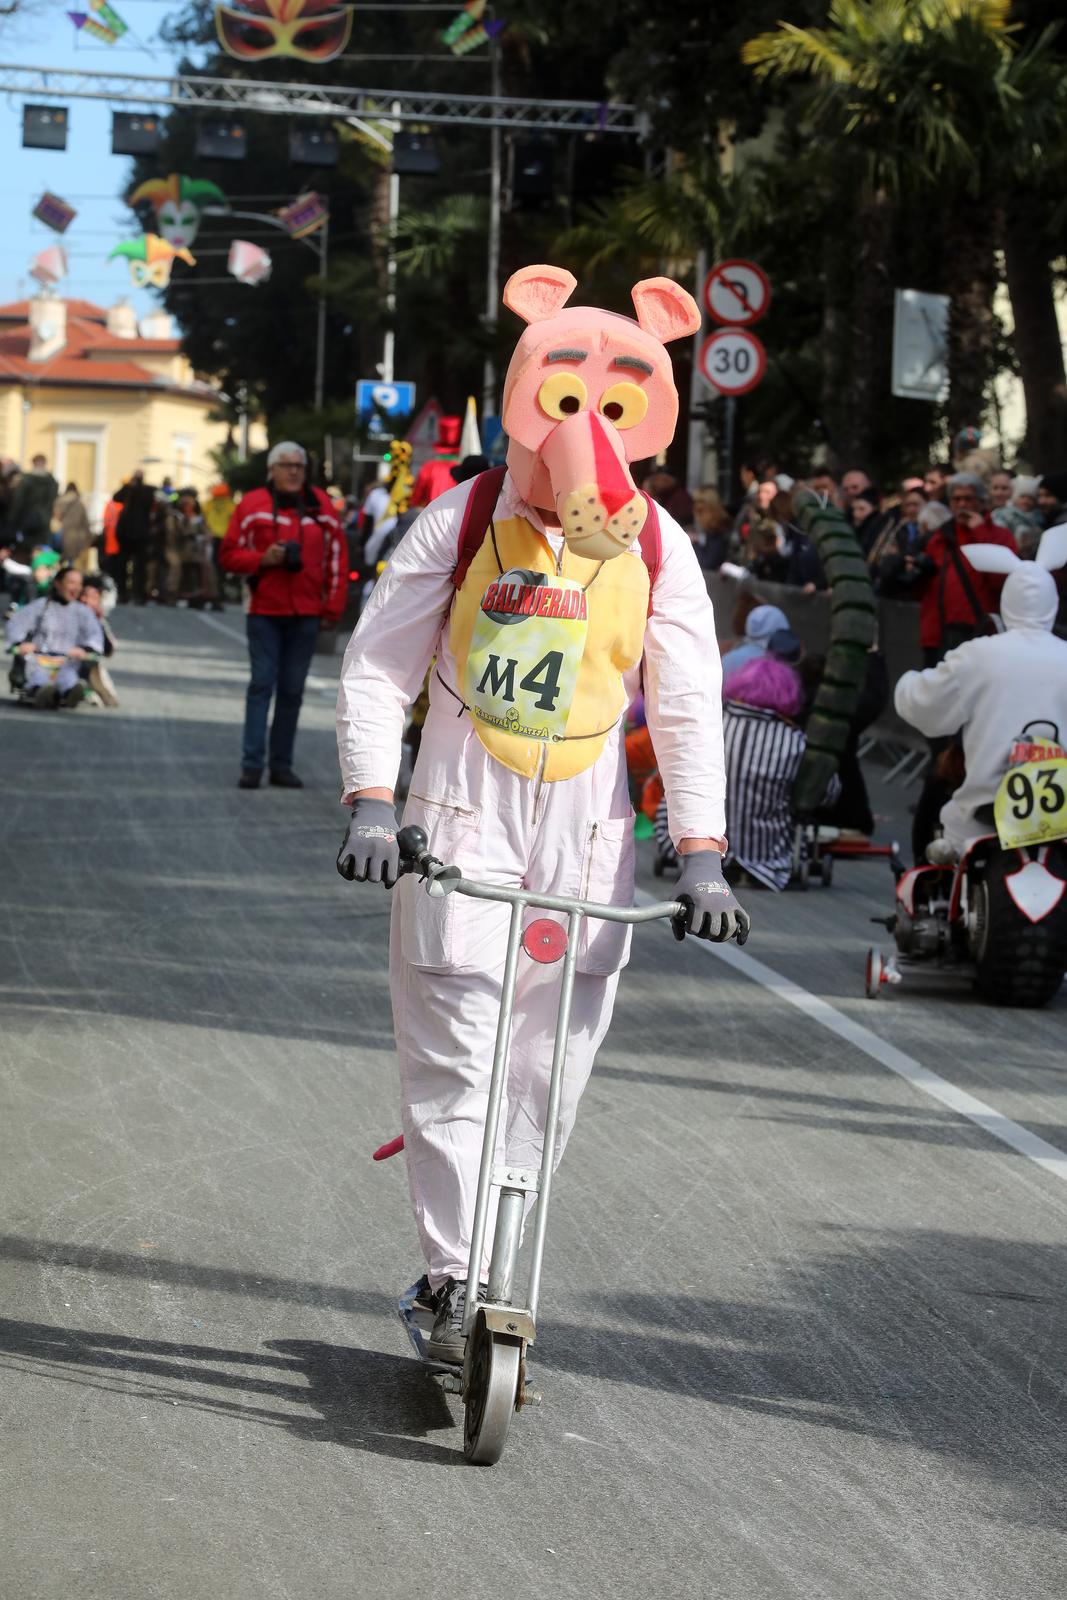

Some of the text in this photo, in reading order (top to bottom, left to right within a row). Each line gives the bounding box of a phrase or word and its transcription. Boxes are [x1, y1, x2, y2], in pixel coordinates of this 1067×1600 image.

[714, 348, 750, 374] 30
[482, 583, 587, 620] BALINJERADA
[1007, 769, 1065, 820] 93
